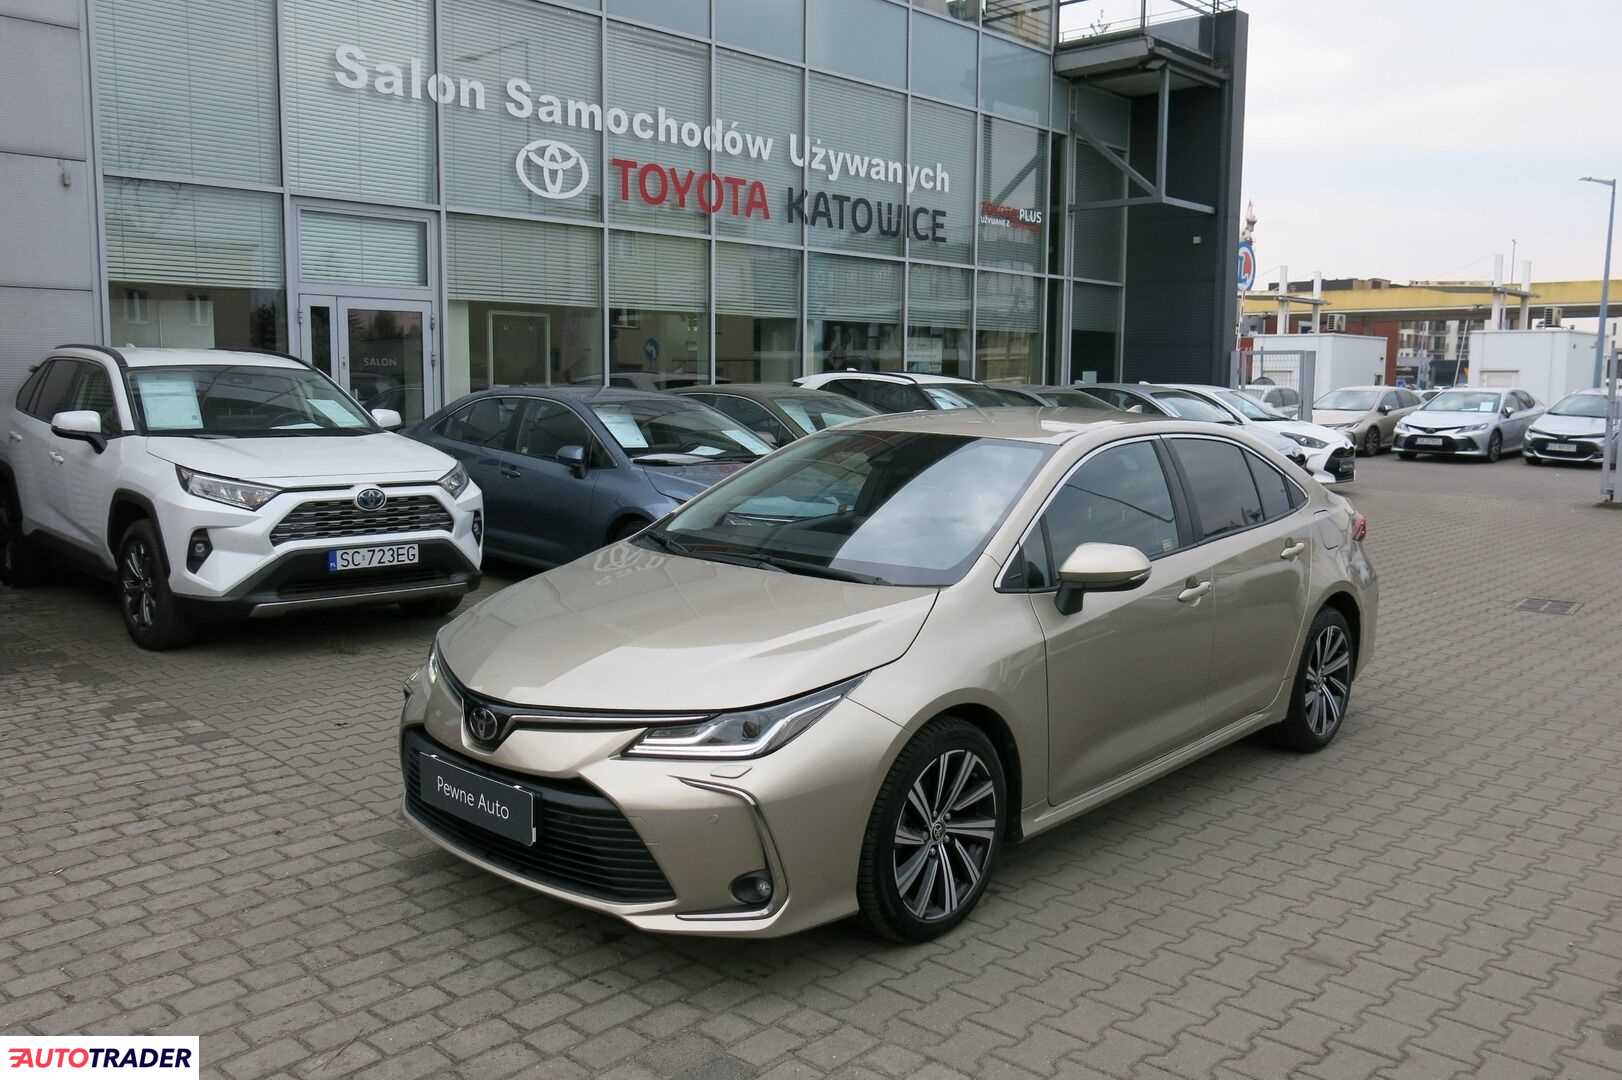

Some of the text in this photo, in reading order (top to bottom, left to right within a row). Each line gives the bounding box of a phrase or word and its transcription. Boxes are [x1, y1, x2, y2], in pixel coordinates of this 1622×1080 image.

[334, 44, 950, 193] Salon Samochodów Używanych
[611, 158, 947, 243] TOYOTA KATOWICE
[1019, 208, 1042, 224] PLUS
[363, 357, 398, 367] SALON
[340, 546, 416, 568] SC 723EG
[437, 775, 510, 820] Pewne Auto
